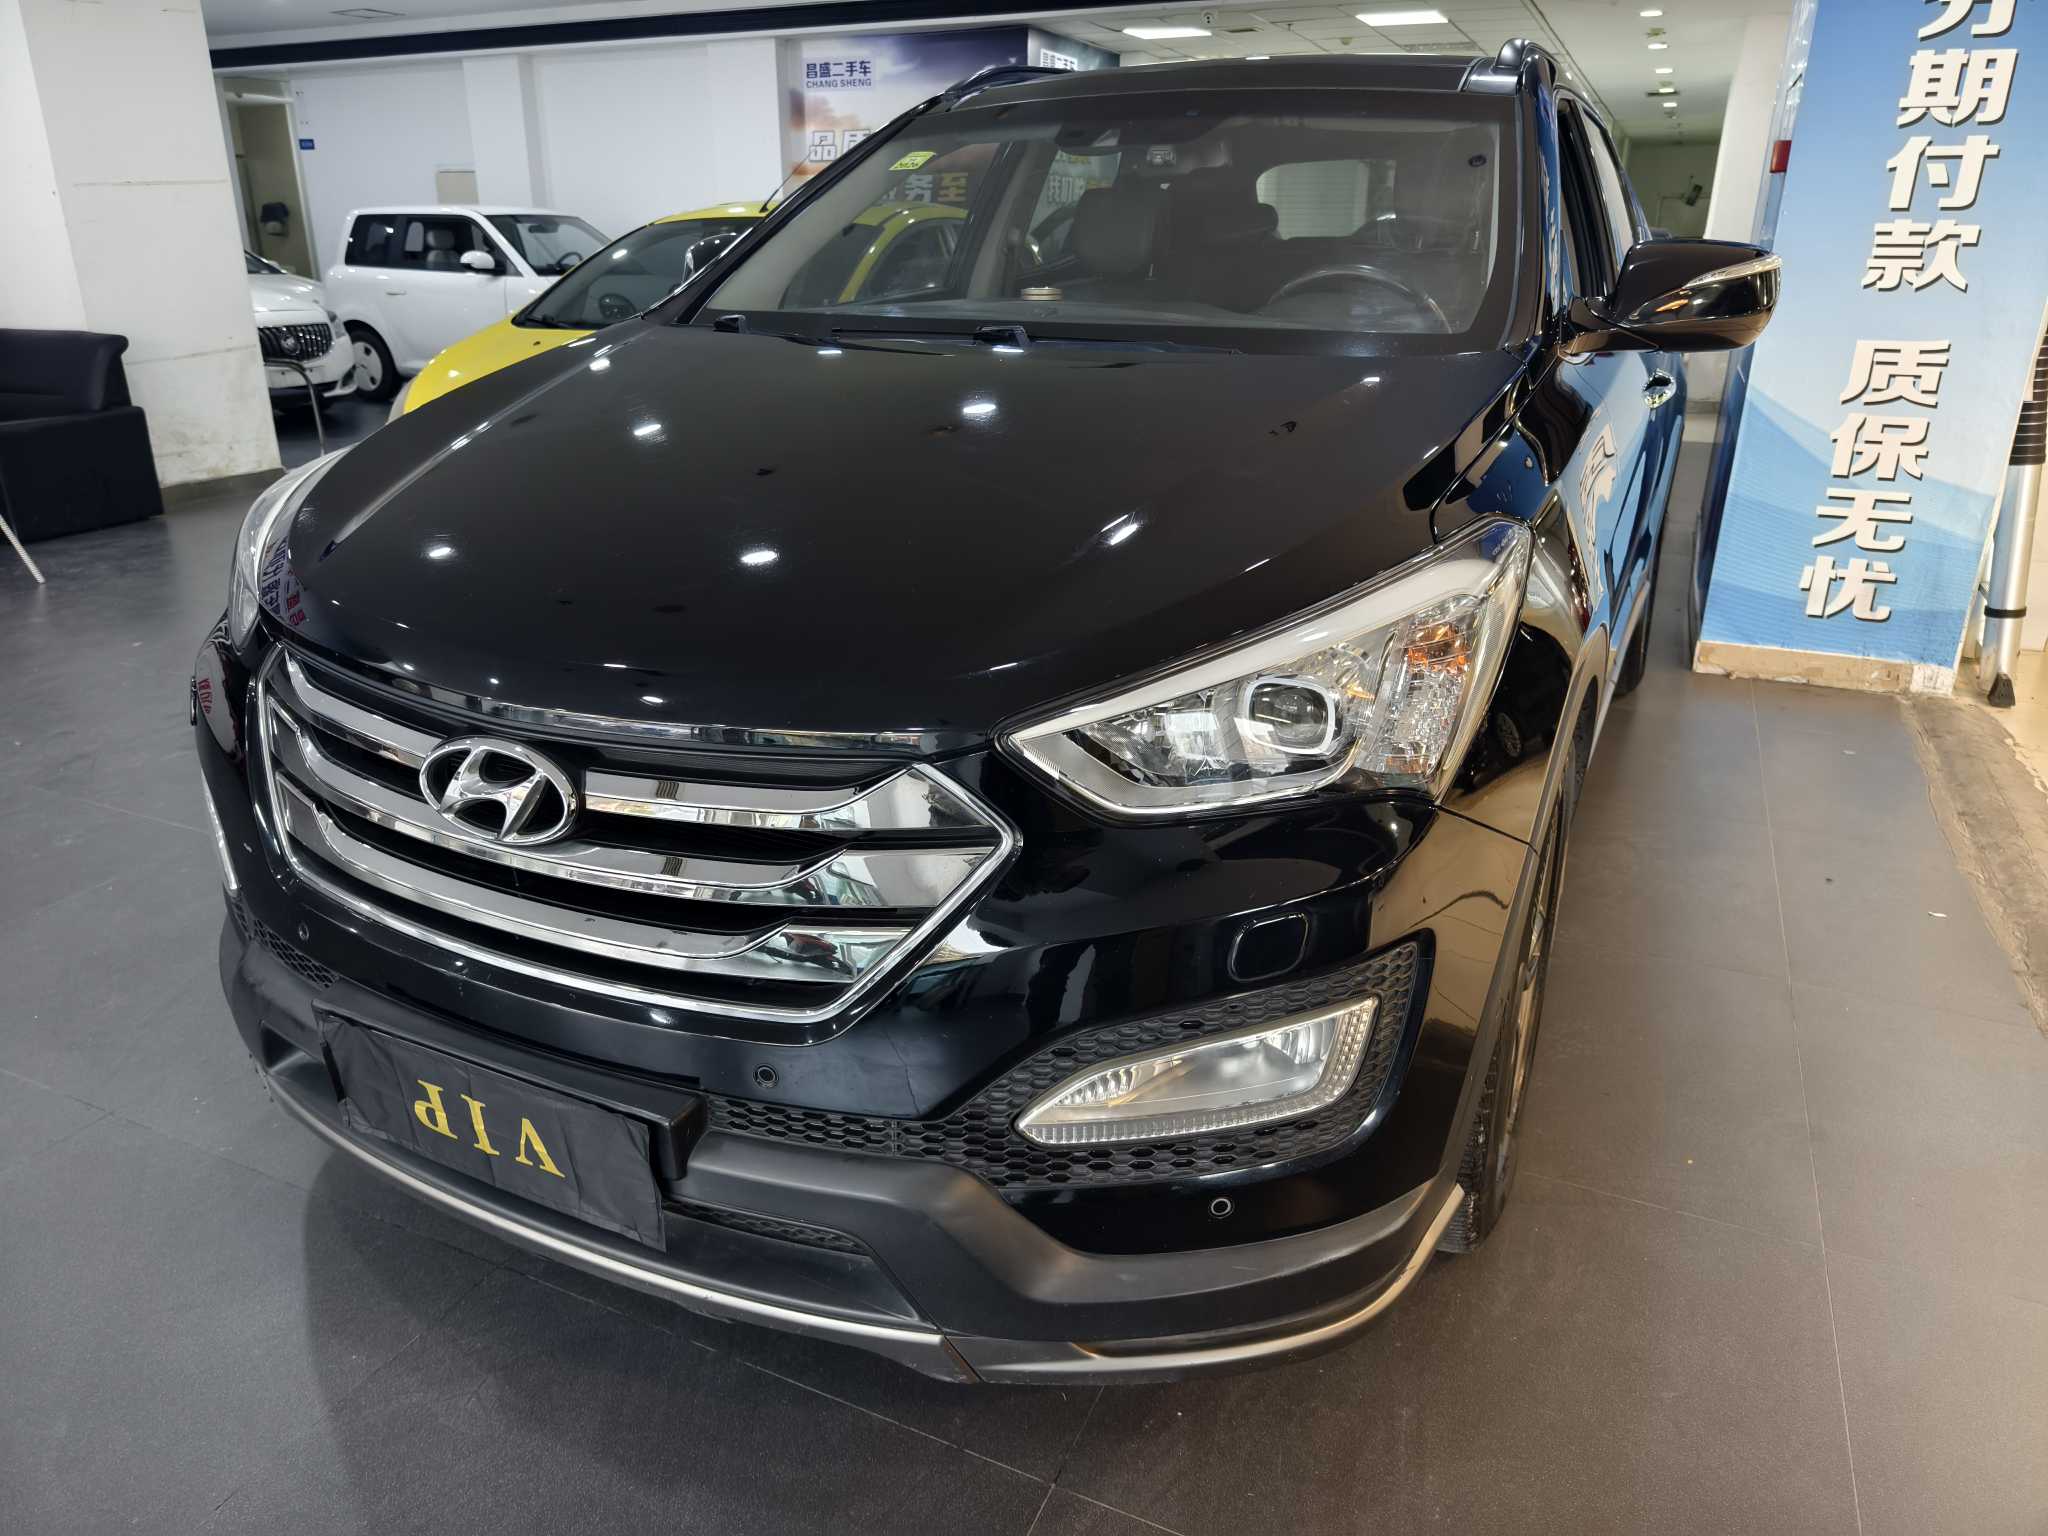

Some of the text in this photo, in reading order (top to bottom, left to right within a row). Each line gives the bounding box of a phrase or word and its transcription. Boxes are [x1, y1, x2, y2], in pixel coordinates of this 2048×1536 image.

[806, 60, 872, 79] 昌盛二手车
[806, 78, 872, 89] CHANG SHENG
[1798, 338, 1951, 623] 质保无忧
[413, 1079, 566, 1179] VIP
